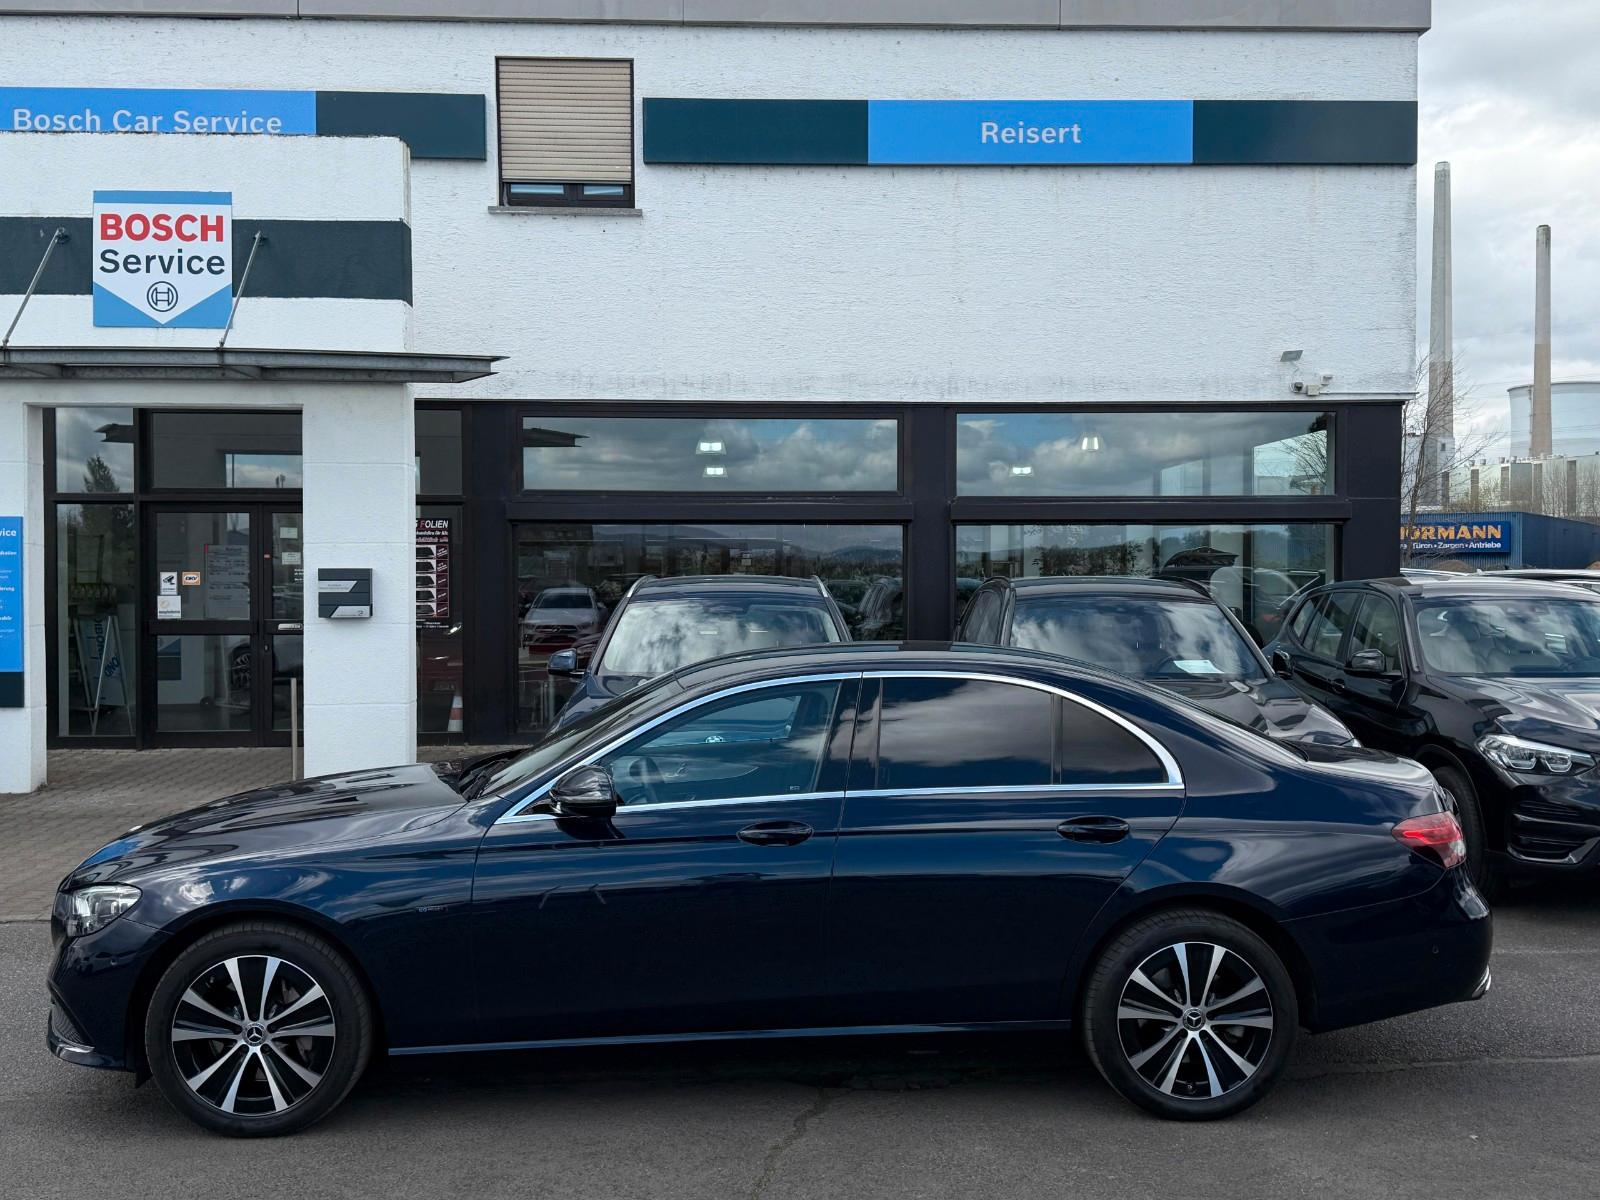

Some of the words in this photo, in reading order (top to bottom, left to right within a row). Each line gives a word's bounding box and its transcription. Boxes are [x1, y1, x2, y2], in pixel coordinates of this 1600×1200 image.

[13, 108, 101, 131] Bosch
[112, 109, 163, 132] Car
[173, 110, 282, 133] Service
[981, 121, 1082, 144] Reisert
[100, 213, 224, 242] BOSCH
[99, 248, 225, 275] Service
[420, 520, 449, 528] FOLIEN
[1469, 541, 1502, 549] Antriebe
